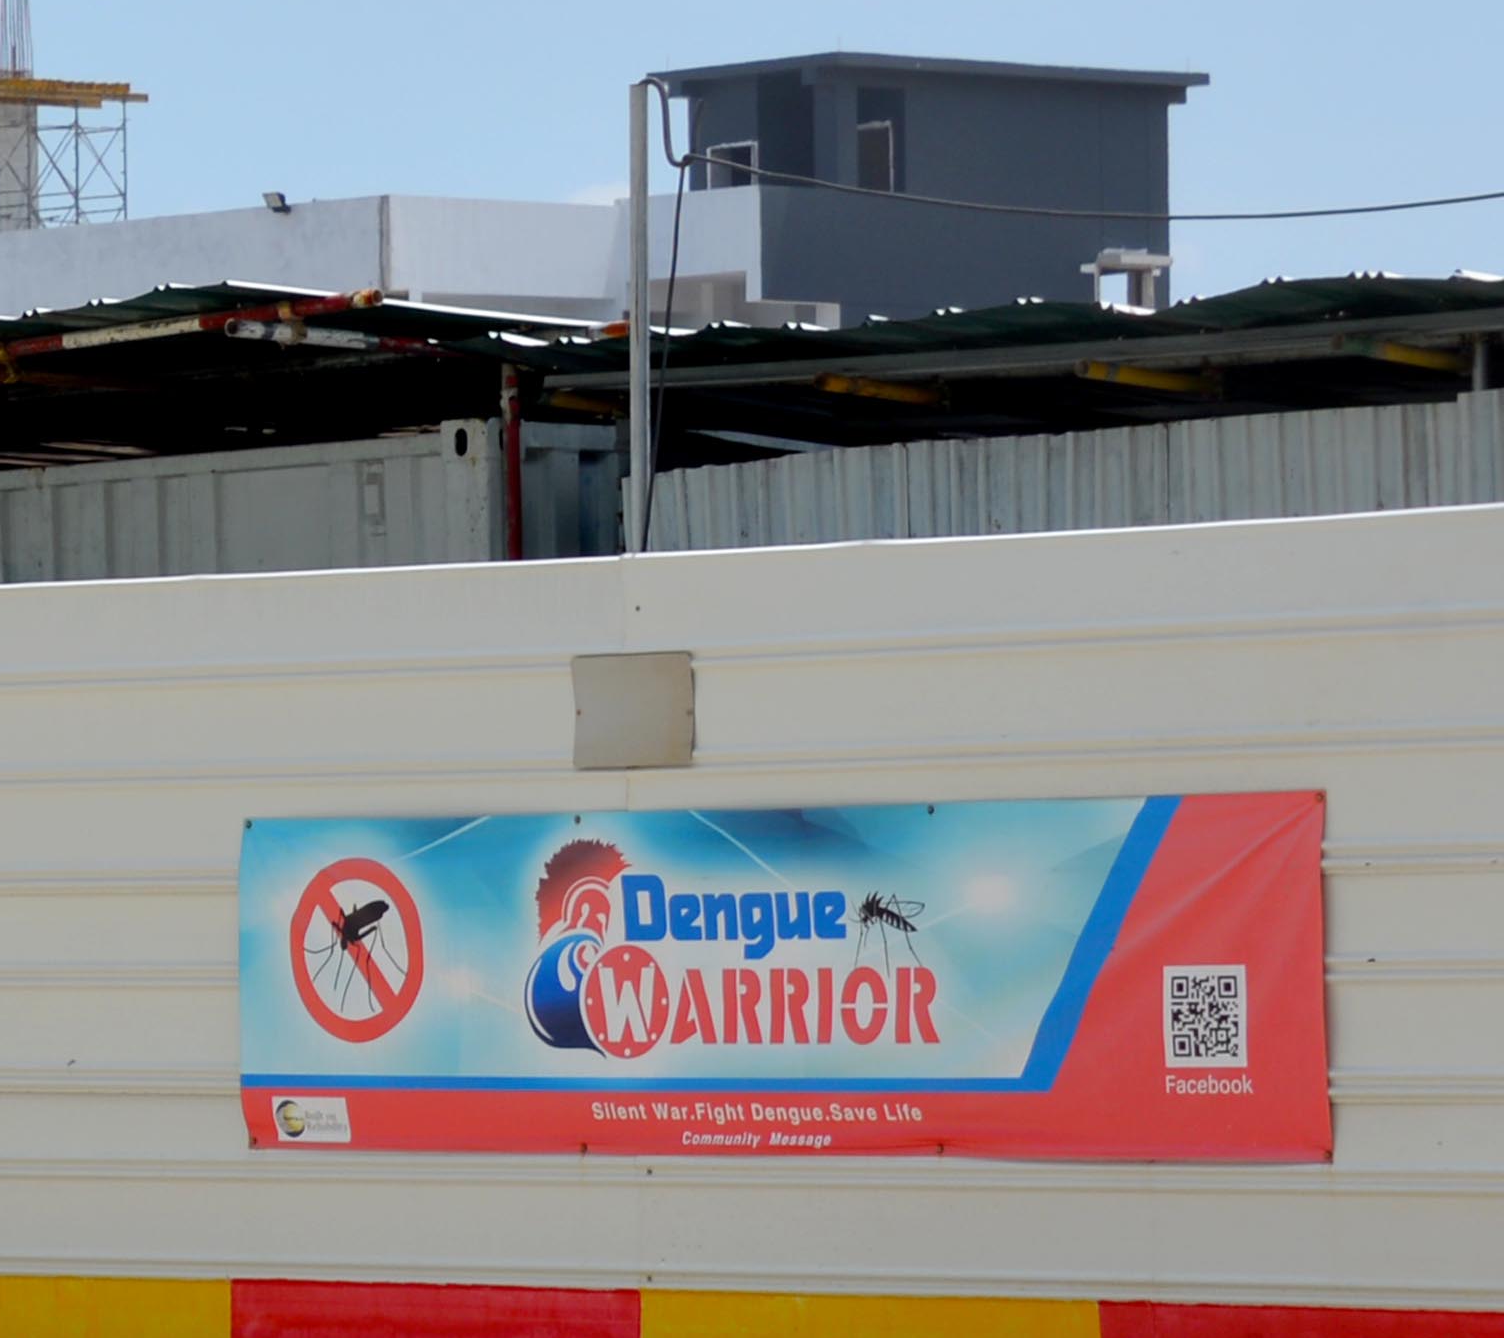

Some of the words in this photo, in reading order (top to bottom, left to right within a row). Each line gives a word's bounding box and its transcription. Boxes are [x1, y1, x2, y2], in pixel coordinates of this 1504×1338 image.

[621, 874, 846, 959] Dengue
[596, 964, 941, 1046] WARRIOR
[1165, 1074, 1254, 1096] Facebook
[591, 1102, 647, 1121] Silent
[884, 1102, 924, 1122] Life
[682, 1131, 761, 1149] Community
[769, 1131, 833, 1149] Message
